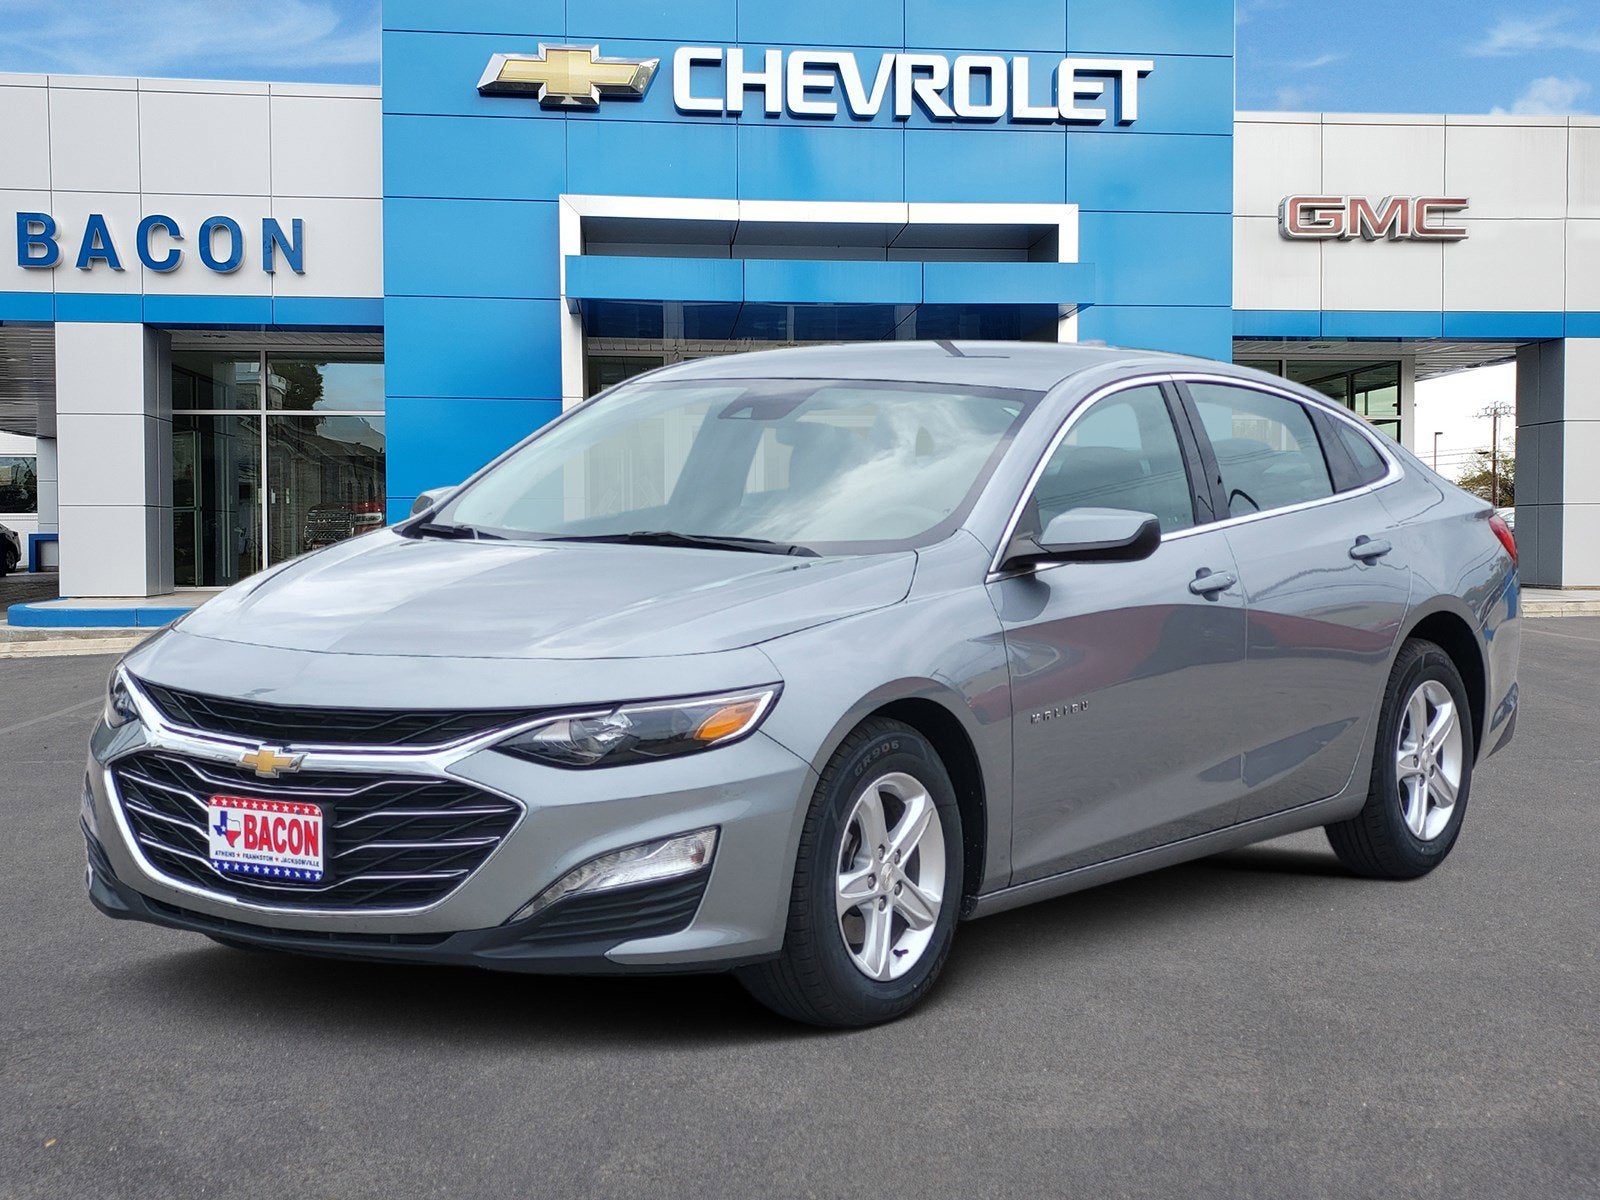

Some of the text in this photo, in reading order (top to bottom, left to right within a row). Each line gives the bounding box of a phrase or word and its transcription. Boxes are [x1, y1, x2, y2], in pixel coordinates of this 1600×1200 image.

[673, 46, 1154, 125] CHEVROLET
[1279, 194, 1469, 241] GMC
[16, 211, 306, 276] BACON
[1030, 700, 1089, 724] MALIBU
[243, 813, 319, 857] BACON
[214, 850, 320, 868] ATHENS FRANKSTON JACKSONVILLE
